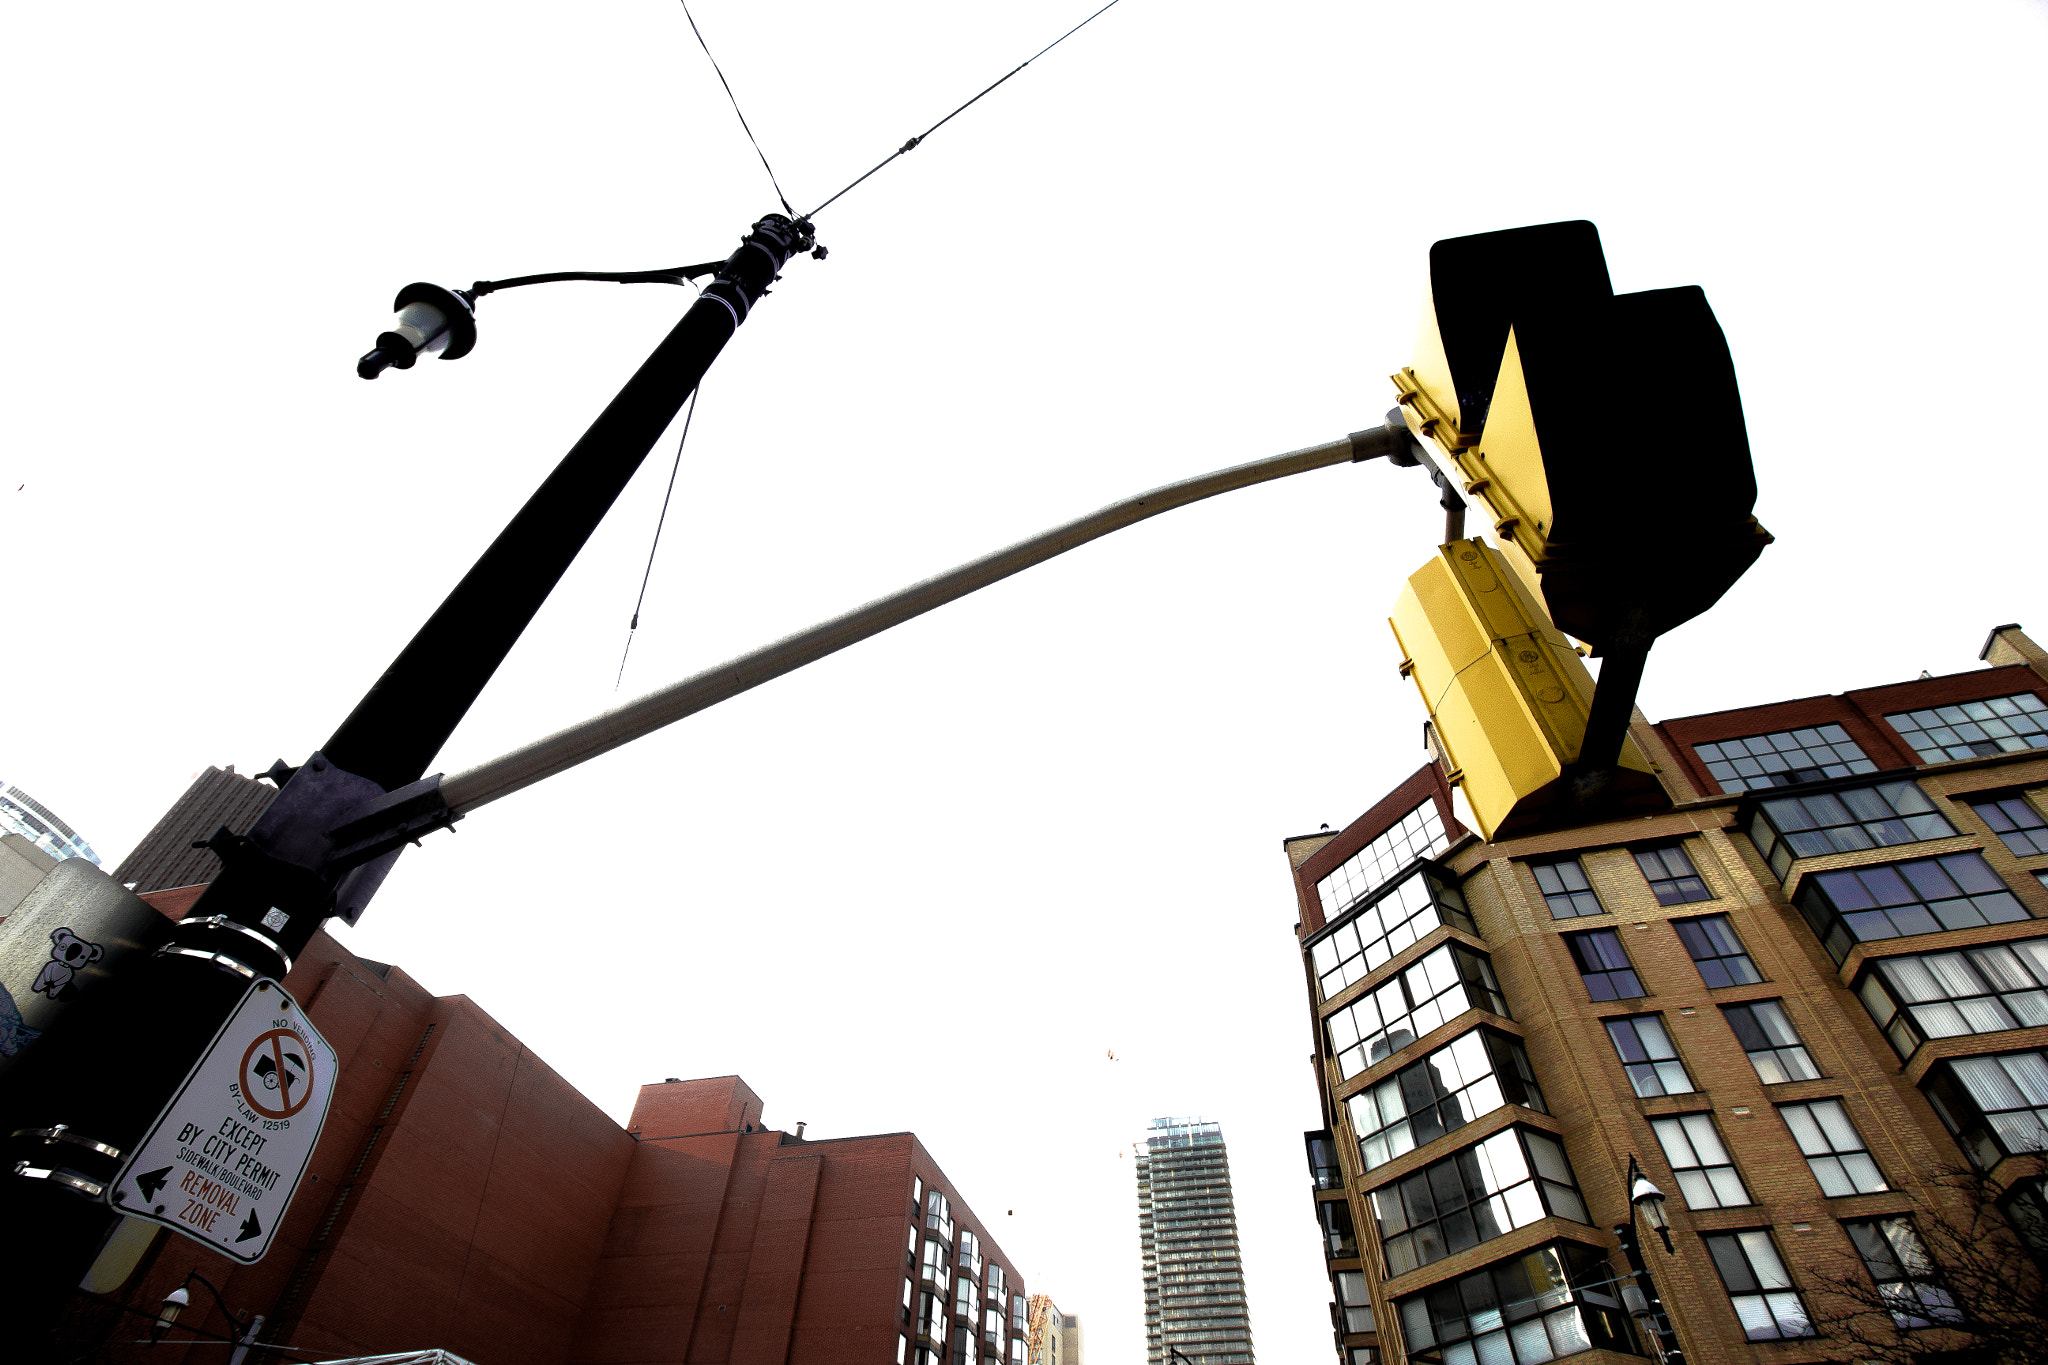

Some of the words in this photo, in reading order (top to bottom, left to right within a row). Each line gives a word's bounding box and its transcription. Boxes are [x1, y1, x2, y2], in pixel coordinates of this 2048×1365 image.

[272, 1018, 288, 1028] NO
[293, 1021, 317, 1061] VENDING
[229, 1083, 259, 1124] BY-LAW
[262, 1119, 291, 1131] 12519
[176, 1122, 204, 1146] BY
[203, 1135, 237, 1164] CITY
[235, 1153, 280, 1191] PERMIT
[218, 1116, 267, 1155] EXCEPT
[180, 1170, 240, 1216] REMOVAL
[178, 1198, 220, 1233] ZONE
